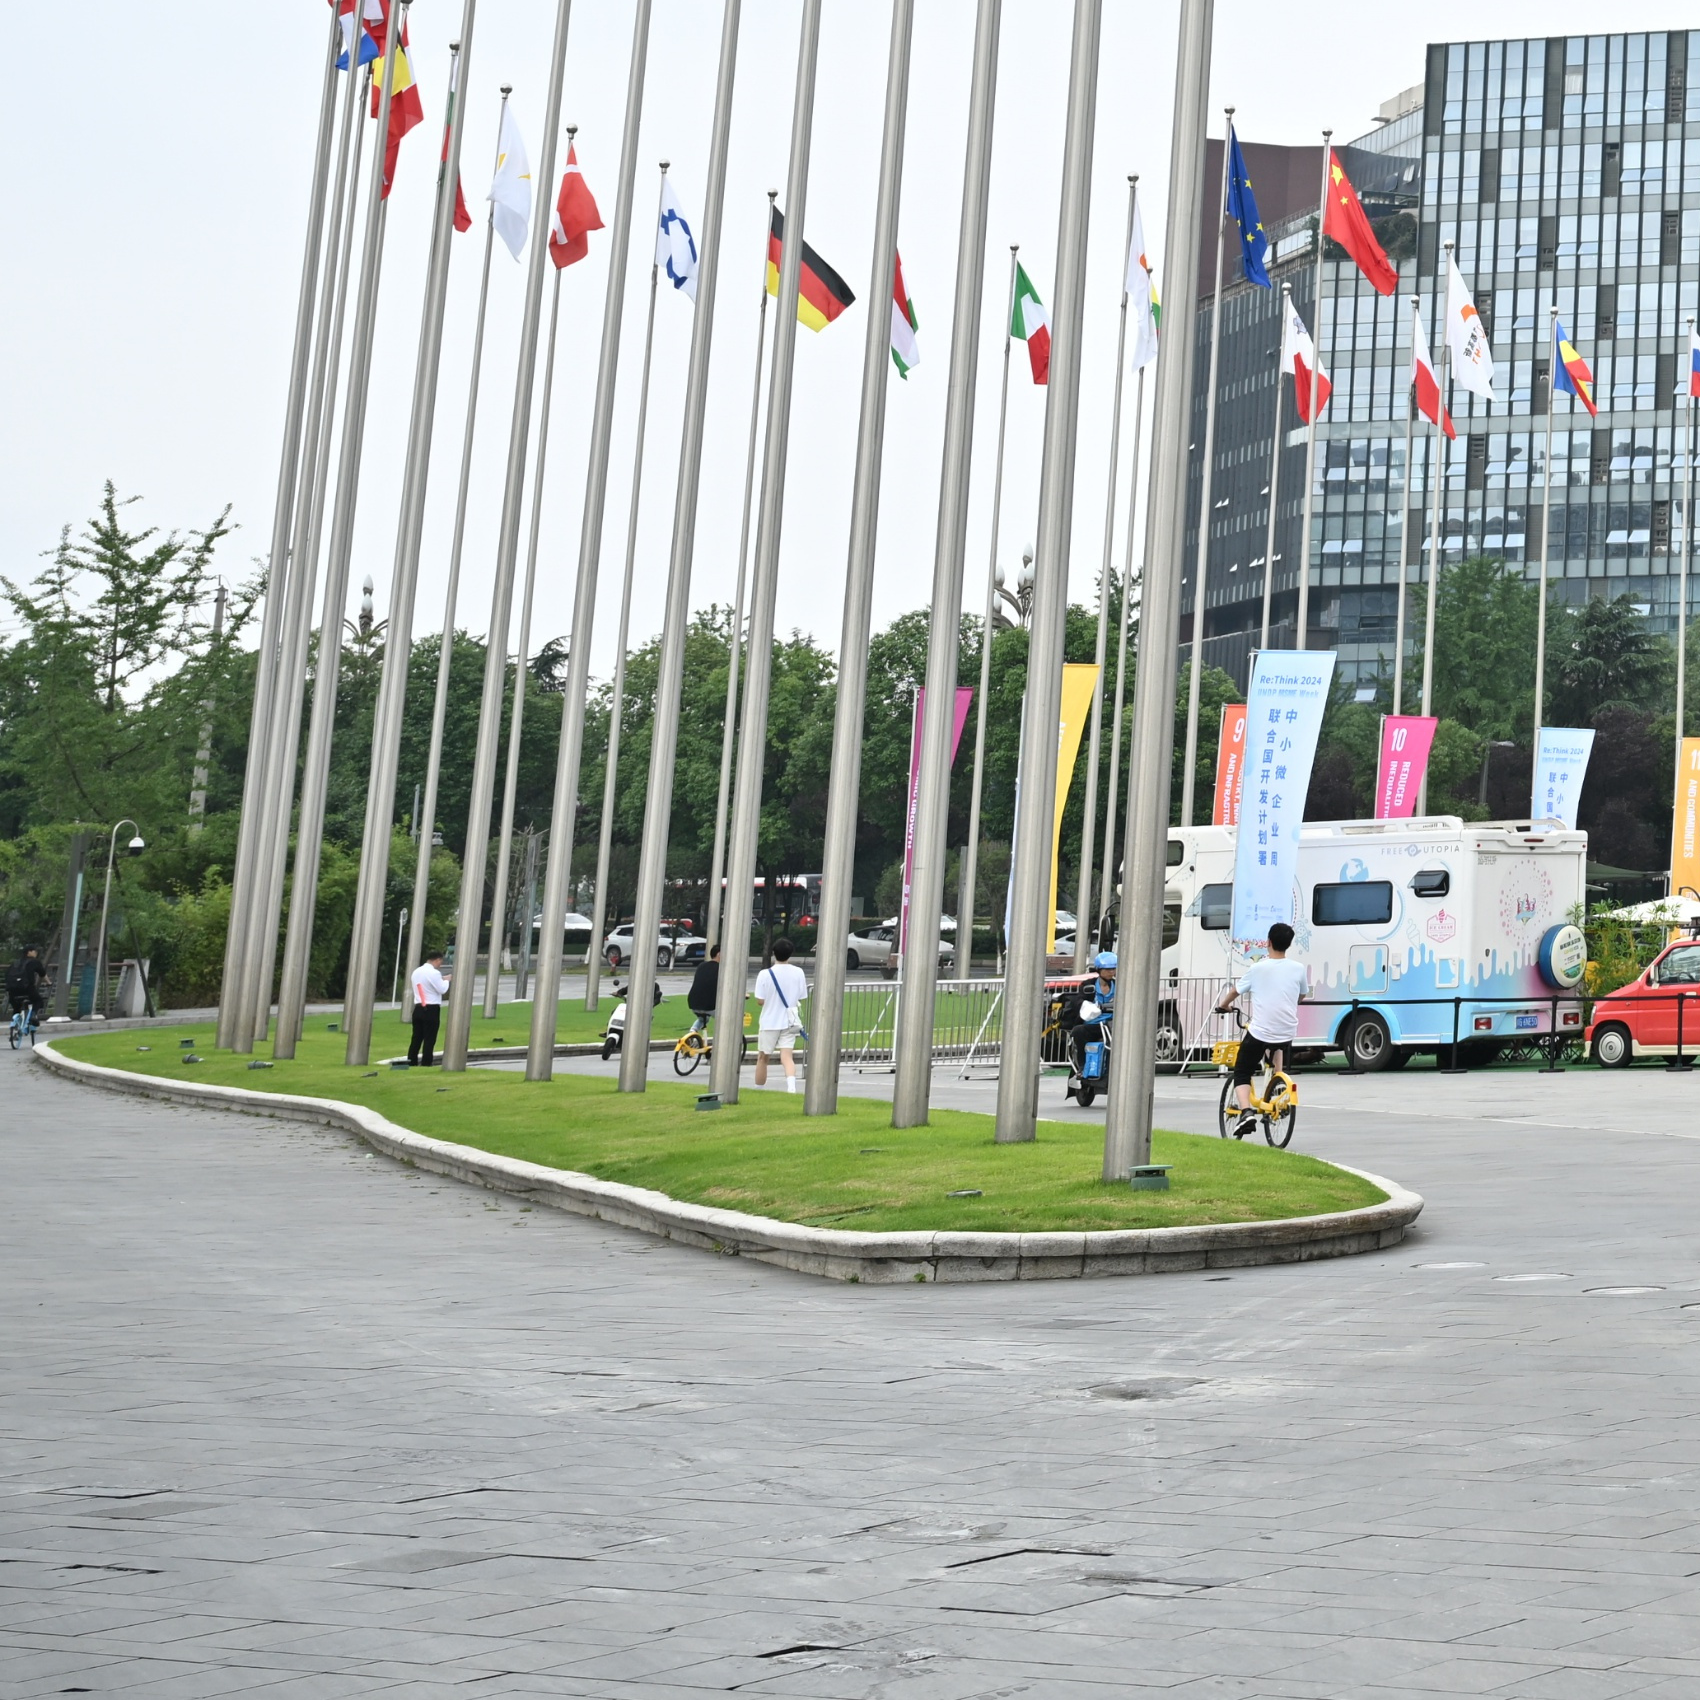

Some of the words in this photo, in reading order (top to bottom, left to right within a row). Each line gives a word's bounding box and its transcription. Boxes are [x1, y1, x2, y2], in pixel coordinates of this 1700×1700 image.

[1260, 675, 1299, 685] Re:Think
[1300, 676, 1322, 686] 2024
[1233, 717, 1245, 743] 9
[1391, 727, 1408, 752] 10
[1228, 753, 1237, 773] AND
[1258, 708, 1281, 866] 联合国开发计划署
[1271, 708, 1298, 866] 中小微企业周
[1394, 761, 1411, 806] REDUCED
[1687, 779, 1698, 798] AND
[1683, 799, 1696, 858] COMMUNITIES
[1381, 847, 1403, 856] FREE
[1423, 845, 1460, 854] UTOPIA
